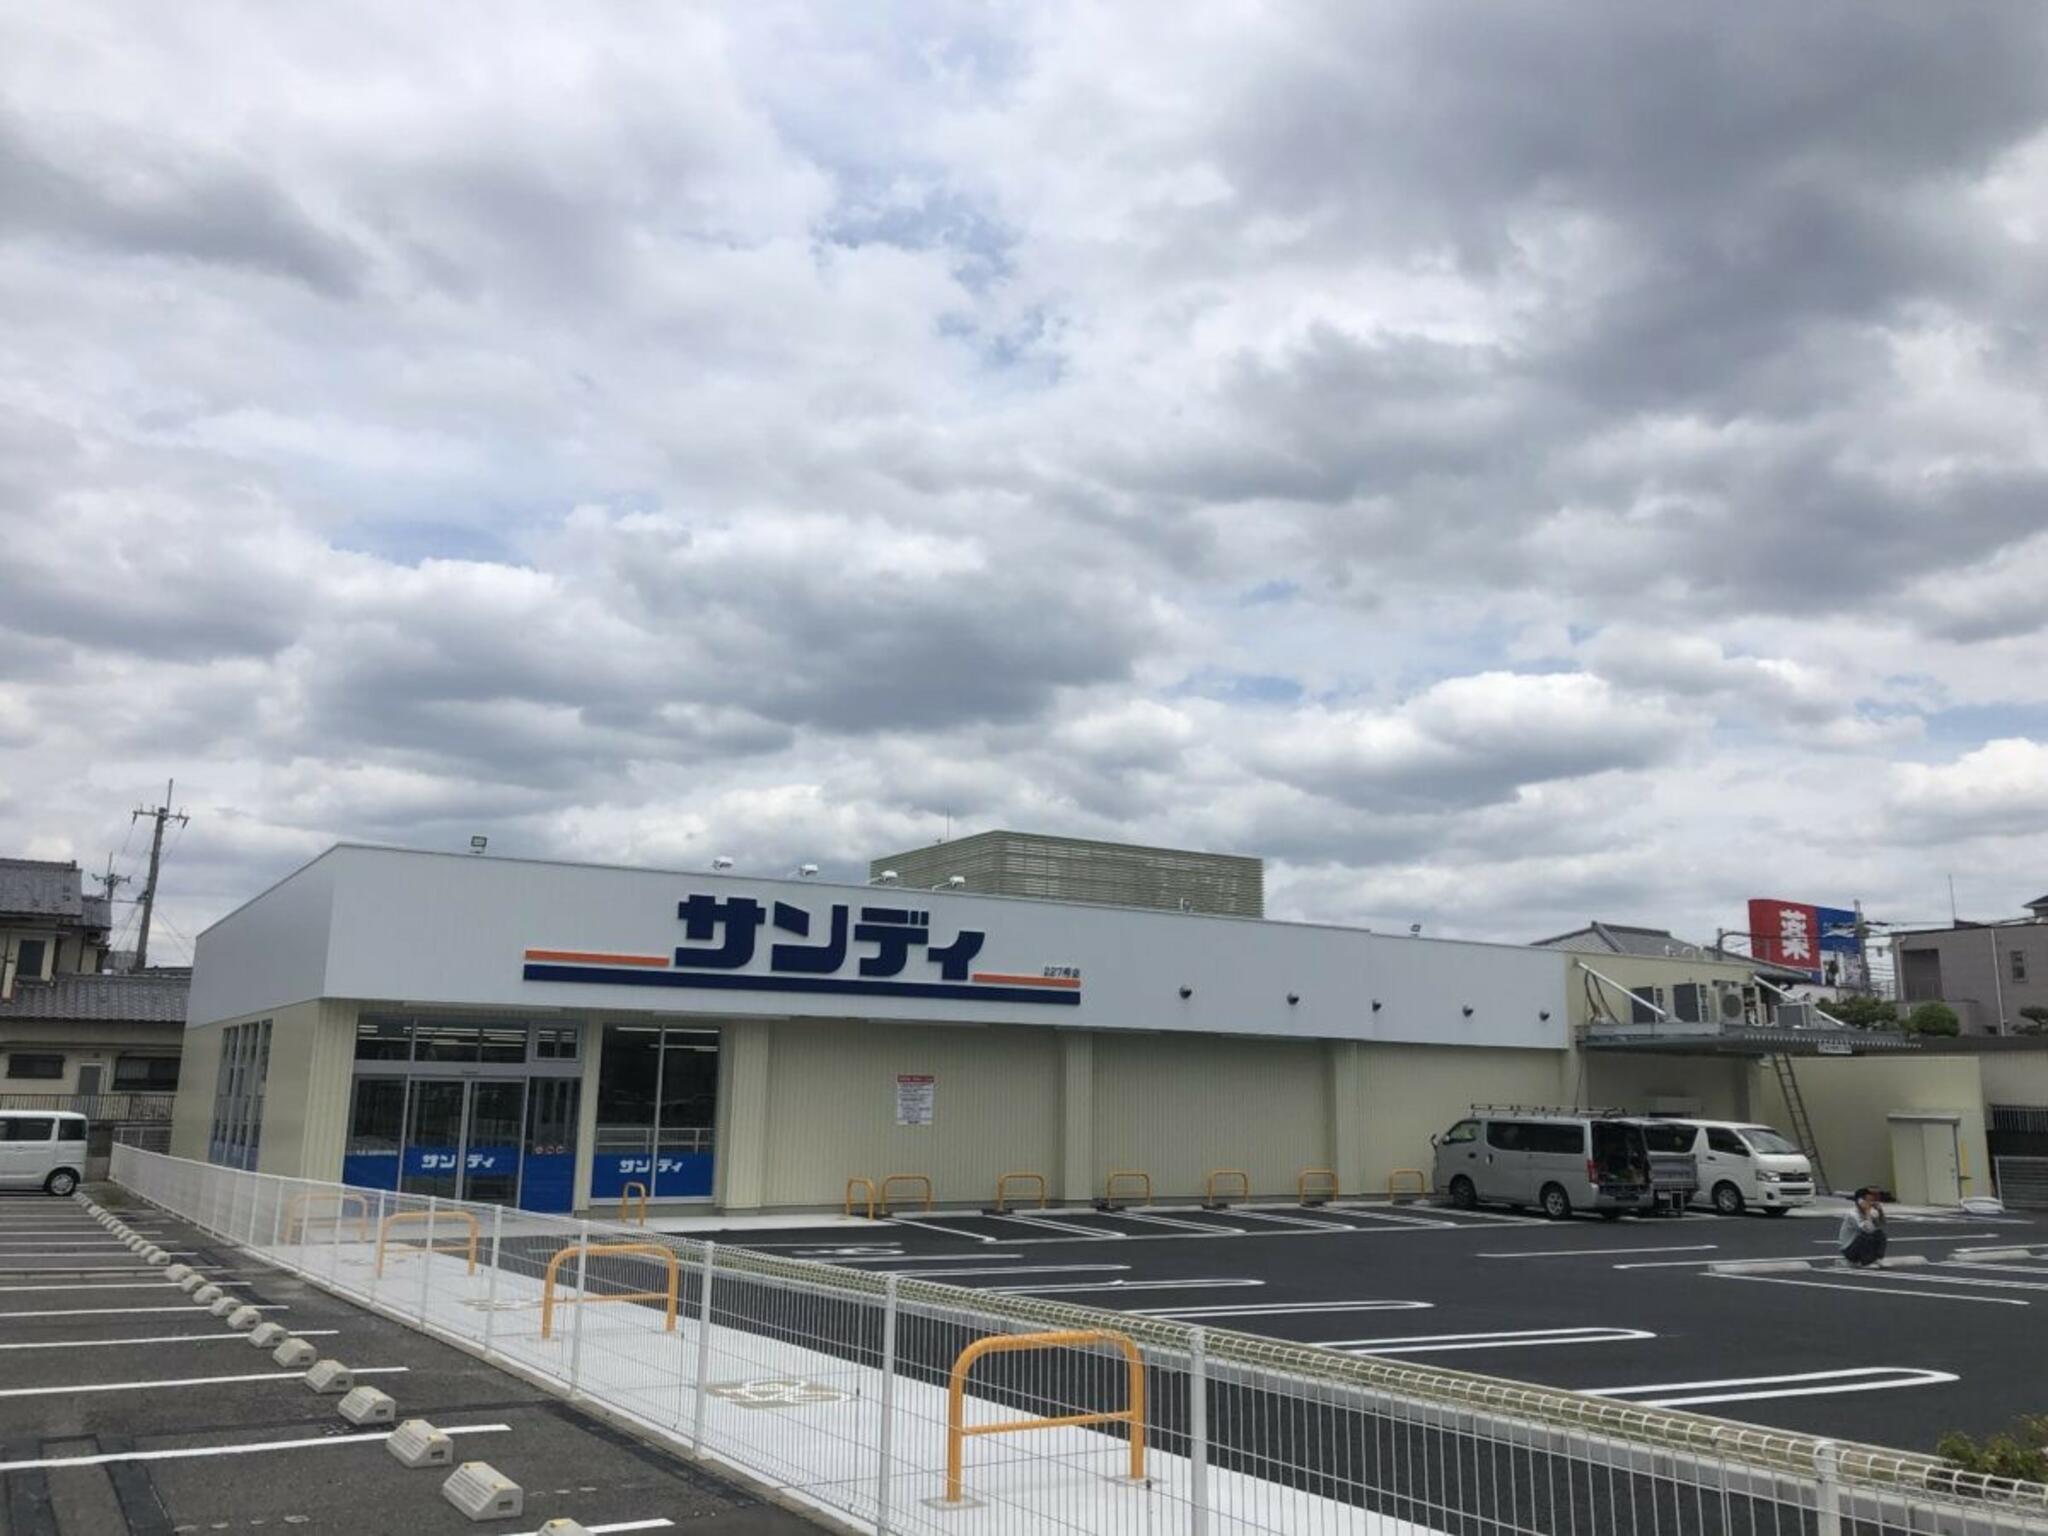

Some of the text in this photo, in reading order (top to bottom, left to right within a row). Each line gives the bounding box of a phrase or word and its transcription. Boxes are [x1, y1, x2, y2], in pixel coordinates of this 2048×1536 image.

[675, 894, 985, 980] サンディ
[1780, 909, 1810, 960] 薬
